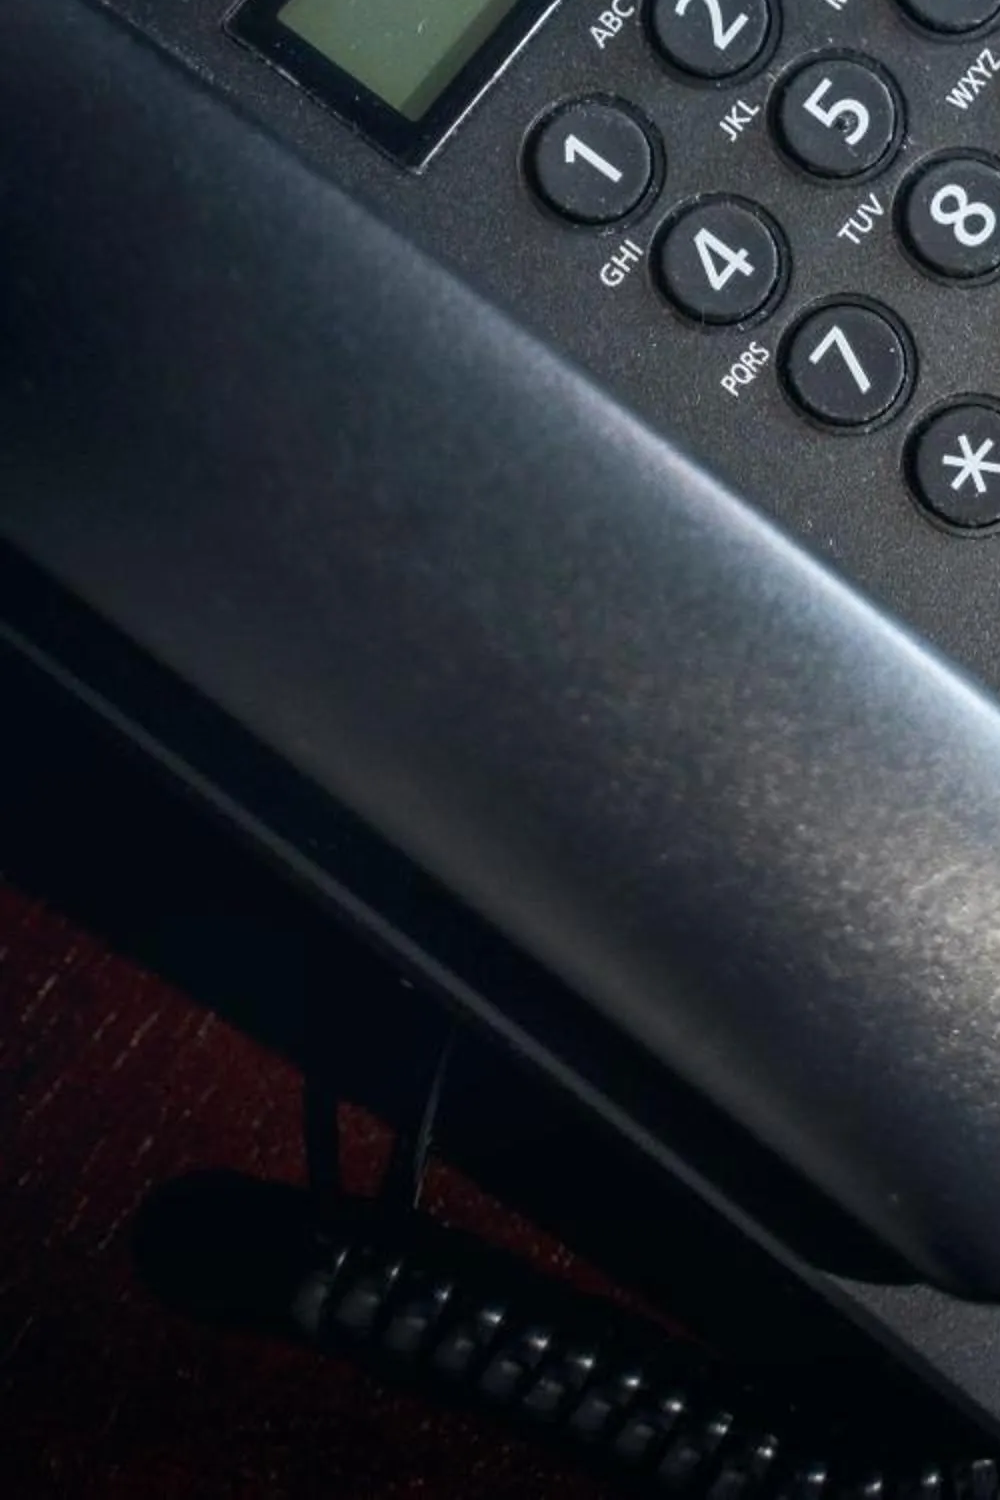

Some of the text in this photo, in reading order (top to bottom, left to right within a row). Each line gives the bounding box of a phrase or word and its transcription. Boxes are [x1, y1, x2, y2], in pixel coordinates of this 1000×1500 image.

[719, 99, 760, 143] JKL
[802, 77, 870, 146] 5
[564, 133, 623, 183] 1
[836, 192, 884, 245] TUV
[930, 183, 997, 247] 8
[599, 238, 644, 287] GHI
[693, 227, 755, 291] 4
[719, 341, 770, 397] PQRS
[809, 325, 871, 394] 7
